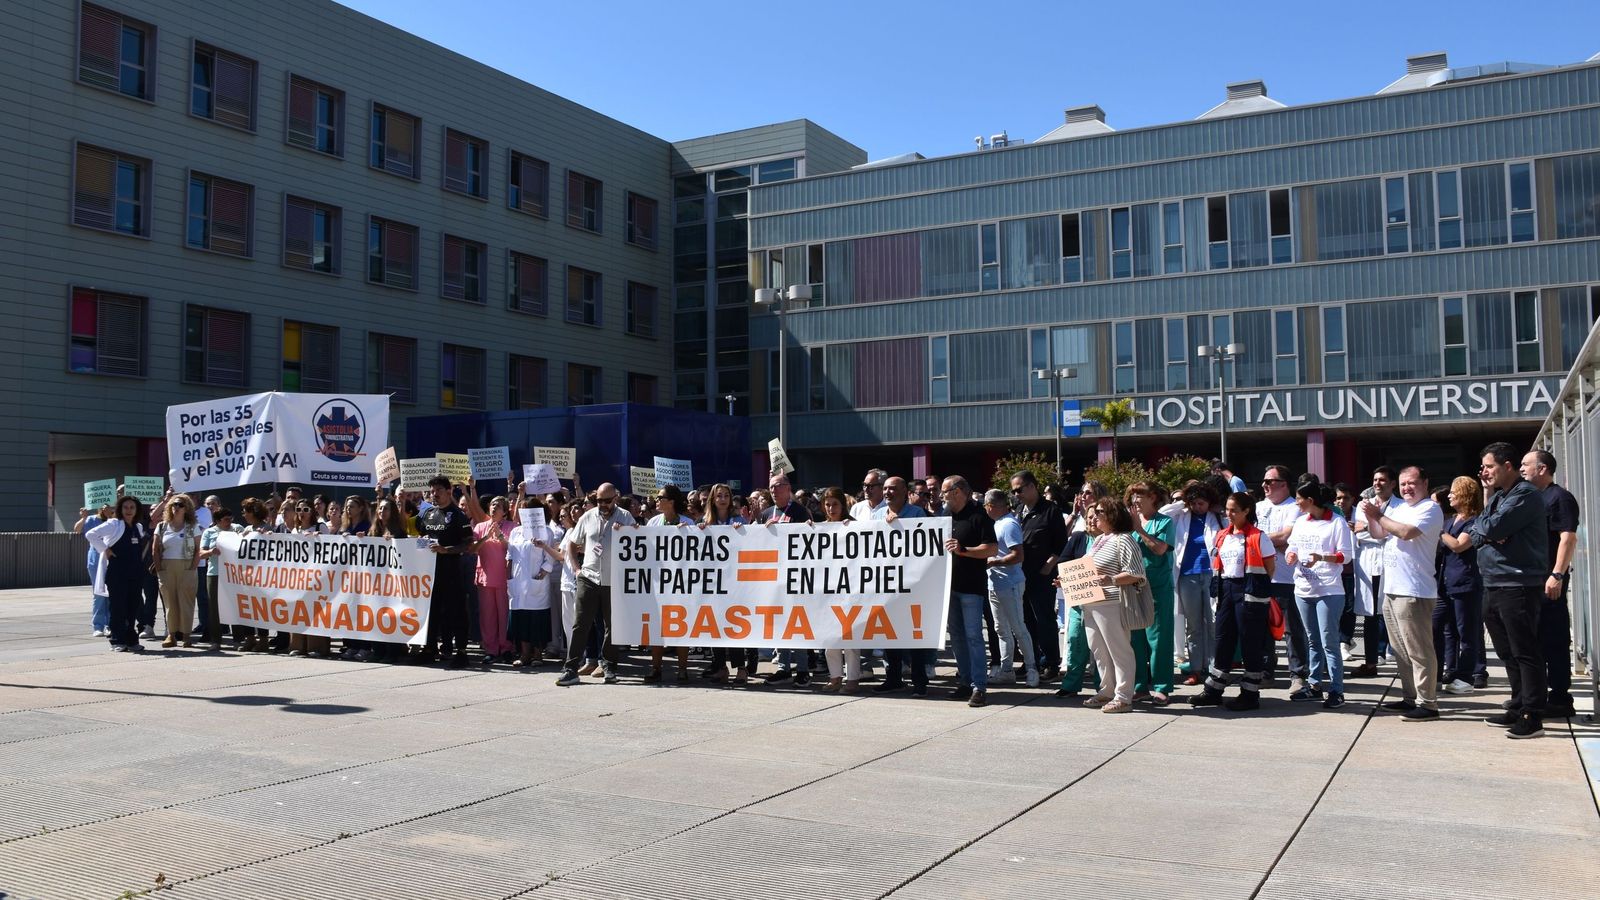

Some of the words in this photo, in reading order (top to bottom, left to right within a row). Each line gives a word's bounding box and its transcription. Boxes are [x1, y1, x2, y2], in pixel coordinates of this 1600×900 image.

[180, 412, 206, 428] Por
[211, 409, 230, 425] las
[234, 405, 253, 421] 35
[1130, 392, 1305, 428] HOSPITAL
[1318, 378, 1567, 420] UNIVERSITA
[182, 428, 223, 445] horas
[228, 421, 273, 439] reales
[183, 447, 200, 462] en
[205, 443, 220, 459] el
[224, 441, 248, 456] 061
[182, 465, 192, 481] y
[197, 460, 211, 476] el
[215, 455, 254, 475] SUAP
[261, 452, 298, 472] ¡YA!
[238, 538, 309, 563] DERECHOS
[314, 542, 402, 569] RECORTADOS:
[619, 535, 647, 562] 35
[655, 535, 729, 562] HORAS
[787, 522, 945, 560] EXPLOTACIÓN
[224, 562, 322, 592] TRABAJADORES
[327, 570, 336, 592] Y
[341, 571, 431, 598] CIUDADANOS
[624, 568, 651, 594] EN
[660, 568, 728, 595] PAPEL
[787, 568, 815, 595] EN
[824, 567, 850, 594] LA
[860, 565, 911, 594] PIEL
[1070, 580, 1098, 592] TRAMPAS
[1078, 570, 1096, 580] BASTA
[1071, 591, 1094, 600] FISCALES
[237, 594, 420, 636] ENGAÑADOS
